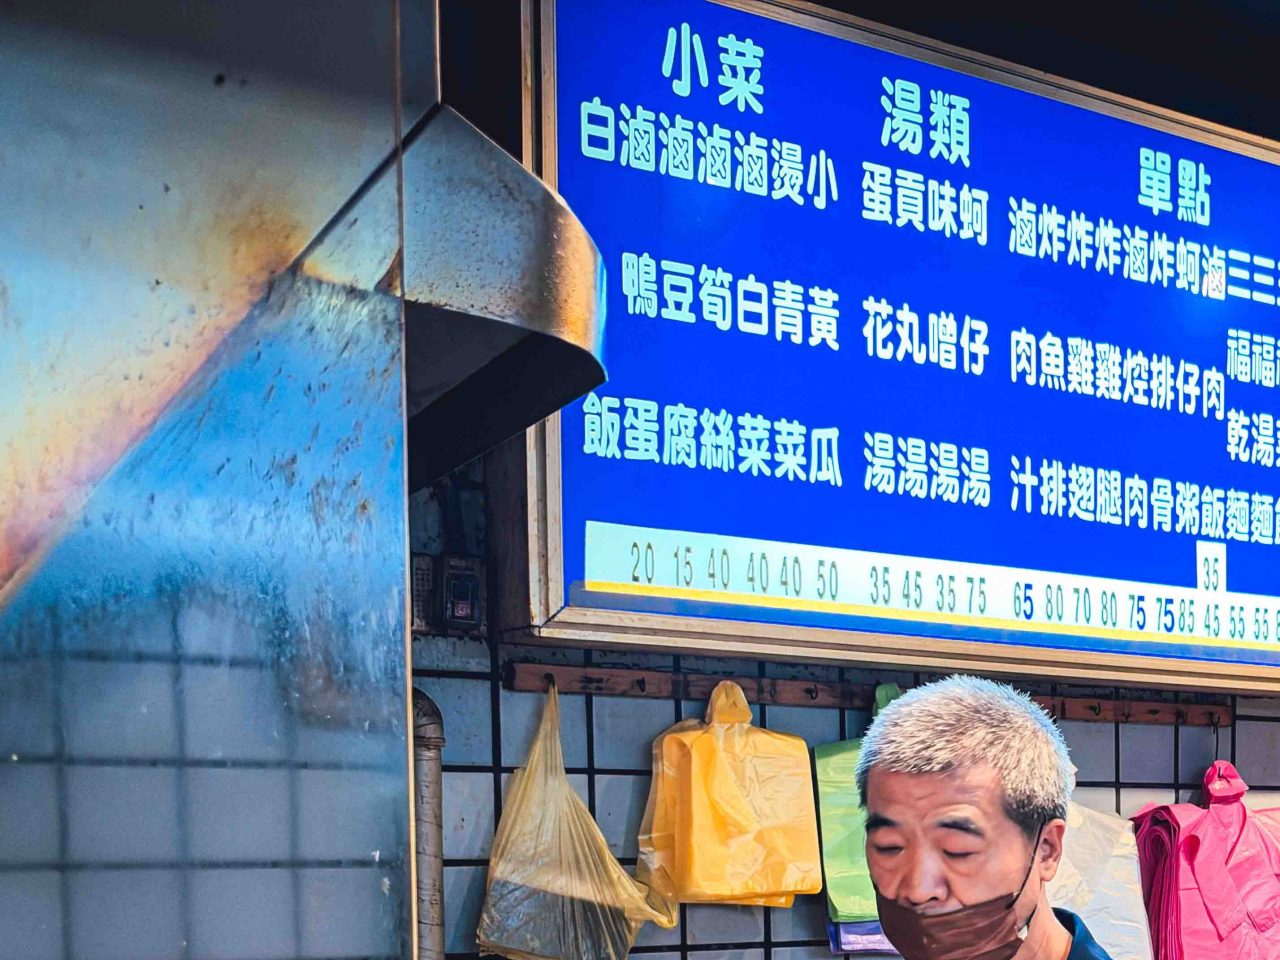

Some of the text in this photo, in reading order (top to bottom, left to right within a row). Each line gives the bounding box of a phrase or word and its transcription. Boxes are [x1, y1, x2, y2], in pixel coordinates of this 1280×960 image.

[662, 22, 765, 114] 小菜
[880, 76, 971, 168] 湯類
[1138, 147, 1212, 227] 單點
[631, 542, 655, 584] 20
[674, 546, 693, 587] 15
[708, 547, 729, 589] 40
[747, 552, 769, 593] 40
[780, 556, 801, 597] 40
[817, 560, 838, 601] 50
[870, 565, 891, 605] 35
[902, 570, 922, 608] 45
[936, 574, 956, 613] 35
[967, 577, 986, 614] 75
[1014, 581, 1034, 620] 65
[1045, 584, 1063, 622] 80
[1073, 587, 1091, 624] 70
[1101, 590, 1117, 627] 80
[1128, 594, 1146, 630] 75
[1156, 597, 1175, 633] 75
[1178, 598, 1195, 633] 85
[1204, 604, 1220, 637] 45
[1229, 605, 1245, 639] 55
[1254, 607, 1269, 640] 55
[1203, 557, 1219, 591] 35
